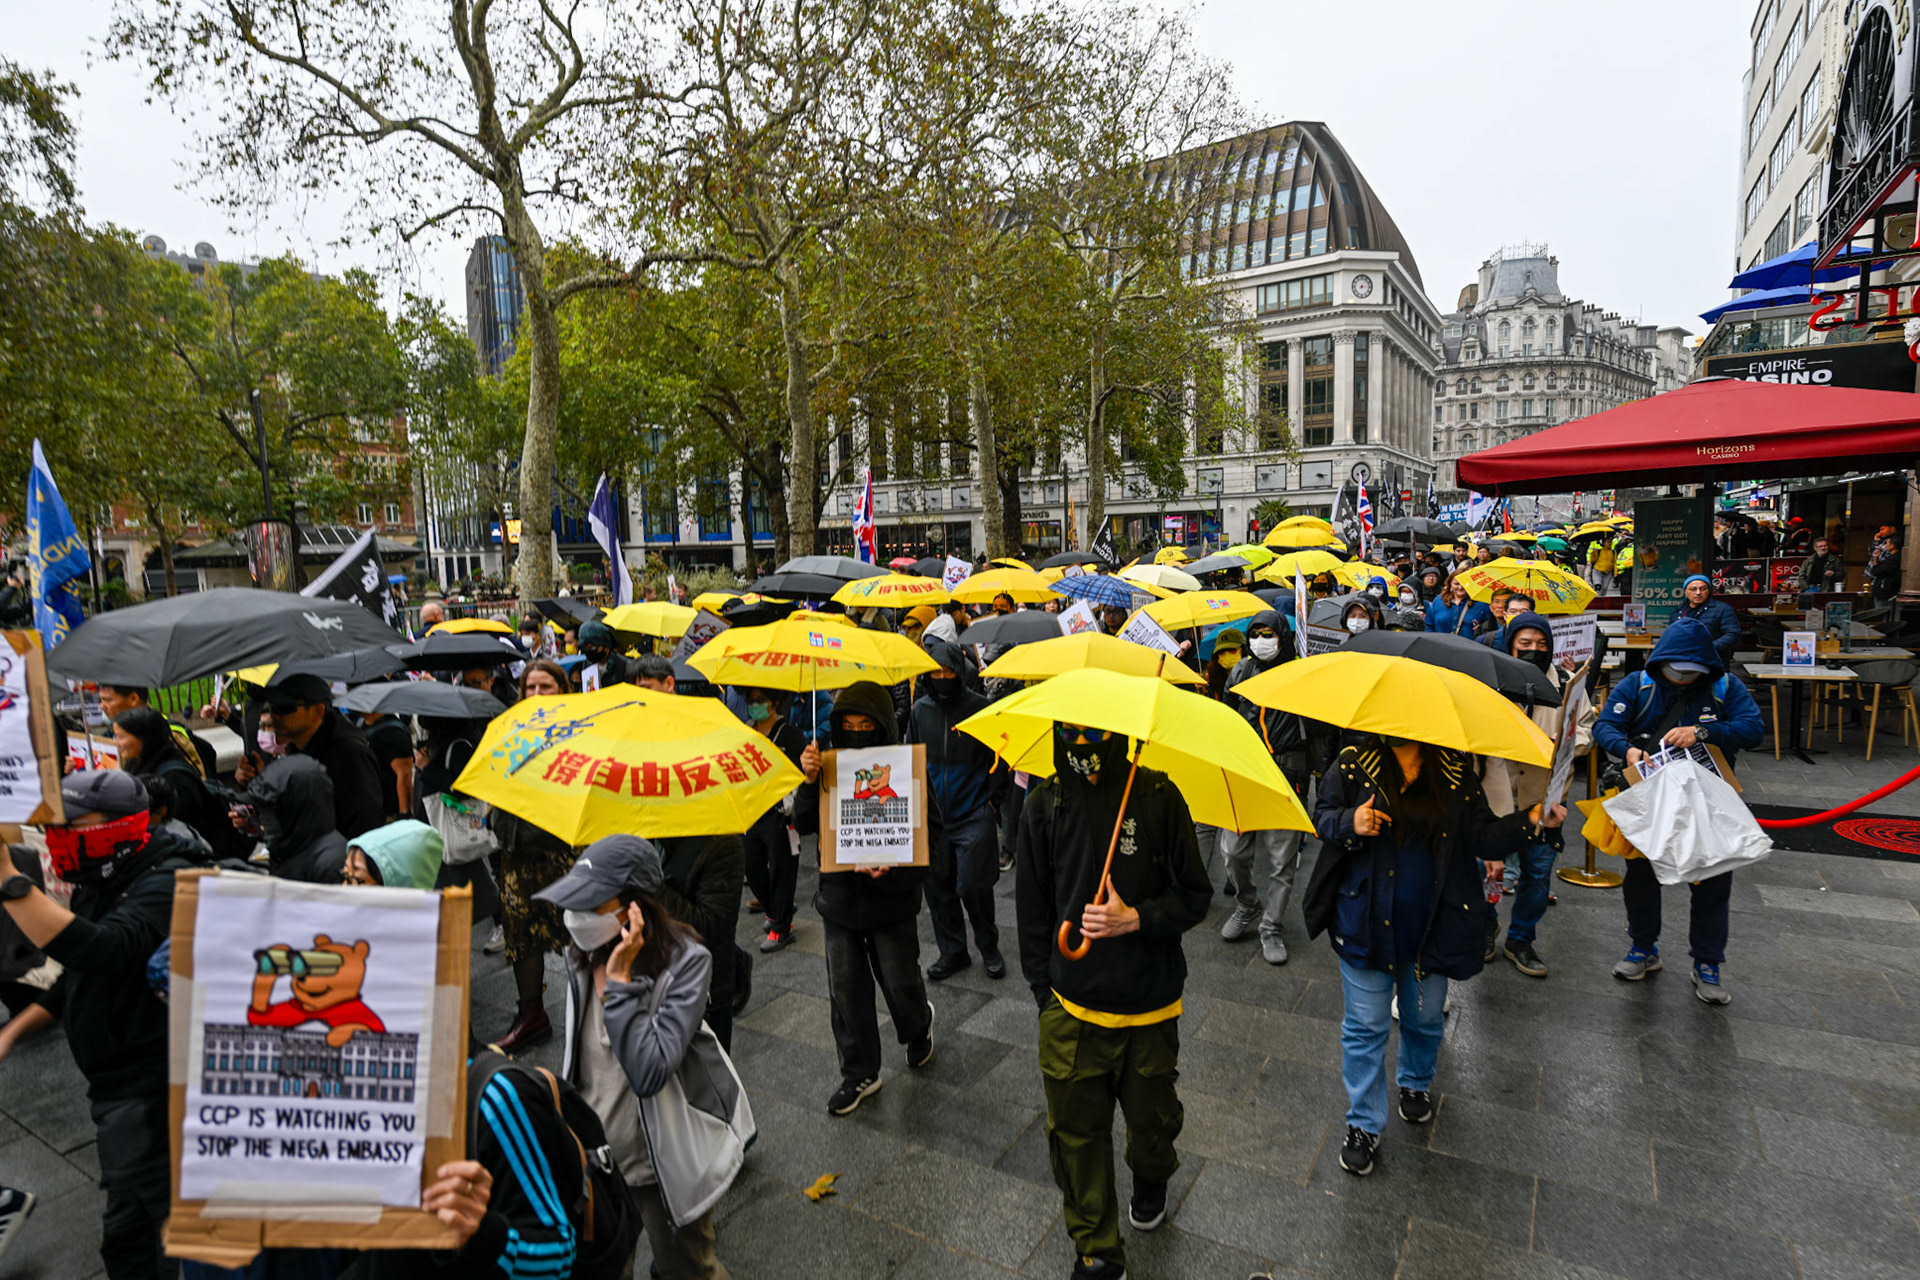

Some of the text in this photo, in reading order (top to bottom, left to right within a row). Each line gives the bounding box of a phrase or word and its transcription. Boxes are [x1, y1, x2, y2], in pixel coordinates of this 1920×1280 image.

[1748, 358, 1806, 374] EMPIRE
[1736, 369, 1833, 386] ASINO
[1696, 443, 1756, 456] Horizons
[1711, 452, 1740, 460] CASINO
[1021, 510, 1050, 519] onald's
[1776, 565, 1800, 575] SPO
[1634, 588, 1668, 599] 50%
[541, 742, 774, 798] 撐自由反惡法
[840, 828, 854, 836] CCP
[864, 827, 895, 835] WATCHING
[840, 839, 853, 847] STOP
[855, 839, 863, 847] THE
[884, 838, 910, 846] EMBASSY
[199, 1105, 416, 1132] CCP IS WATCHING YOU
[197, 1134, 414, 1165] STOP THE MEGA EMBASSY
